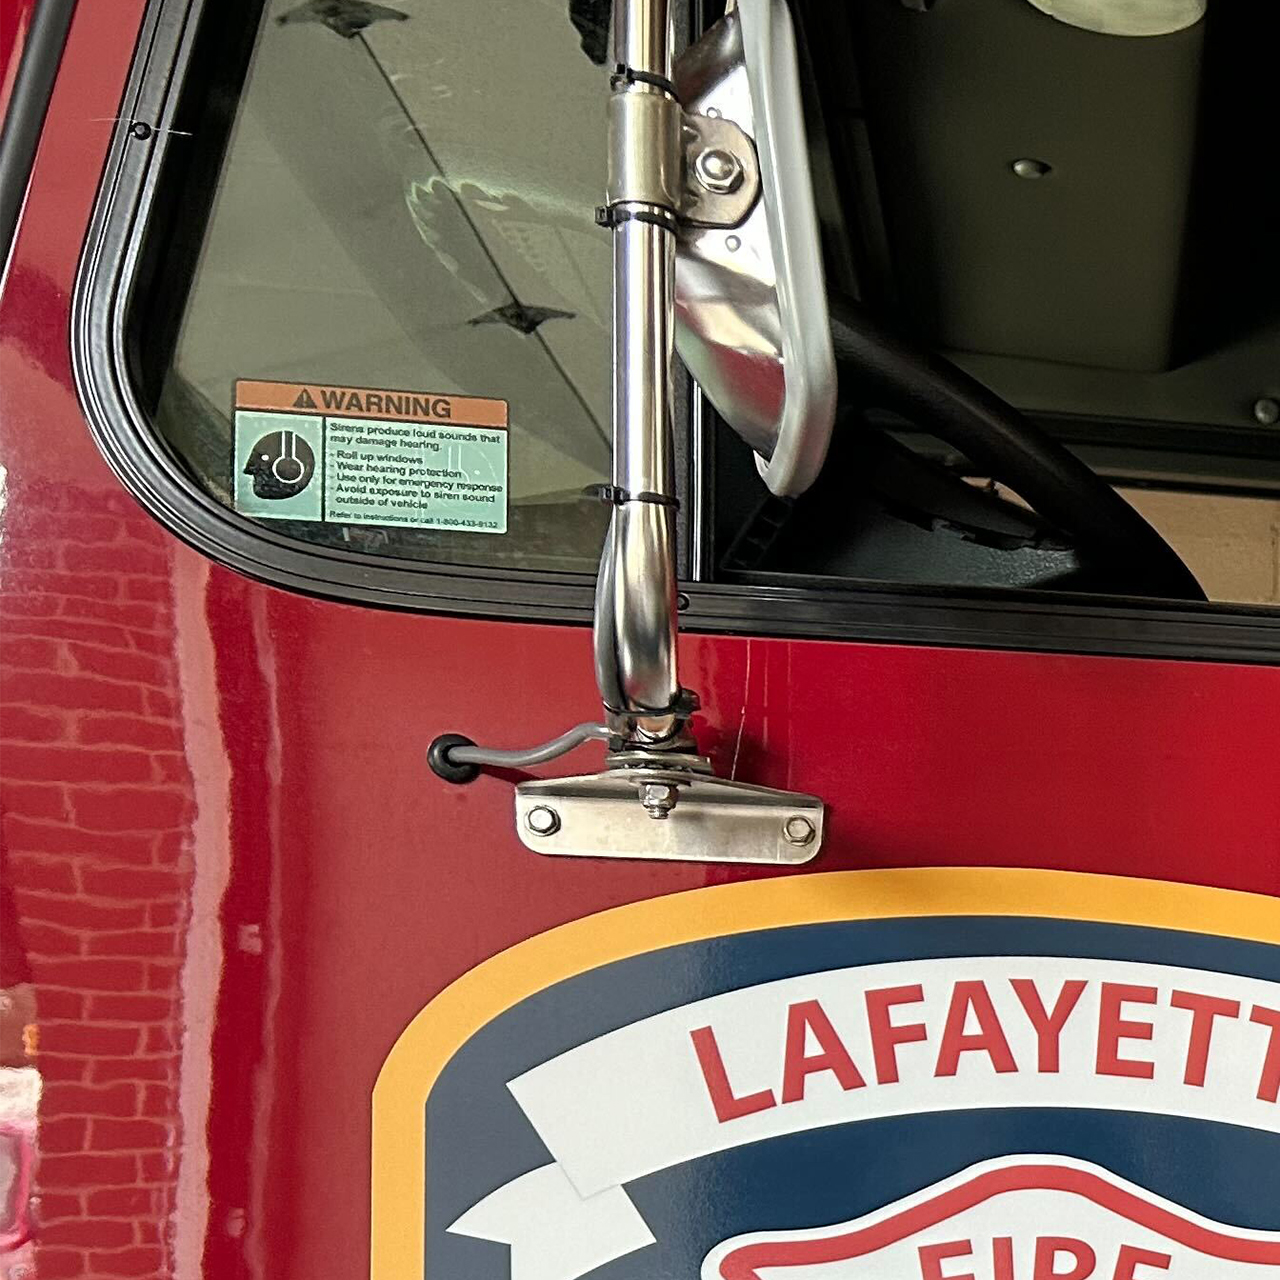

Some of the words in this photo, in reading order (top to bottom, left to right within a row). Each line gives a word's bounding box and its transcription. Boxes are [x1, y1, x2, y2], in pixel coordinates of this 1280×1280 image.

[321, 389, 451, 418] WARNING
[330, 423, 364, 433] Sirens
[367, 426, 410, 437] produce
[413, 427, 436, 438] loud
[439, 430, 477, 441] sounds
[480, 433, 501, 444] that
[330, 435, 353, 445] may
[355, 436, 398, 448] damage
[400, 439, 443, 452] hearing.
[336, 450, 358, 460] Roll
[360, 452, 374, 462] up
[377, 453, 423, 465] windows
[336, 461, 363, 471] Wear
[366, 463, 406, 476] hearing
[408, 467, 462, 479] protection
[336, 472, 357, 481] Use
[359, 474, 380, 485] only
[382, 475, 397, 485] for
[399, 478, 454, 491] emergency
[457, 483, 503, 494] response
[336, 483, 367, 494] Avoid
[369, 486, 418, 498] exposure
[421, 489, 431, 499] to
[433, 489, 460, 500] siren
[463, 493, 495, 503] sound
[336, 495, 375, 505] outside
[378, 496, 389, 506] of
[391, 498, 429, 509] vehicle
[363, 512, 408, 522] instructions
